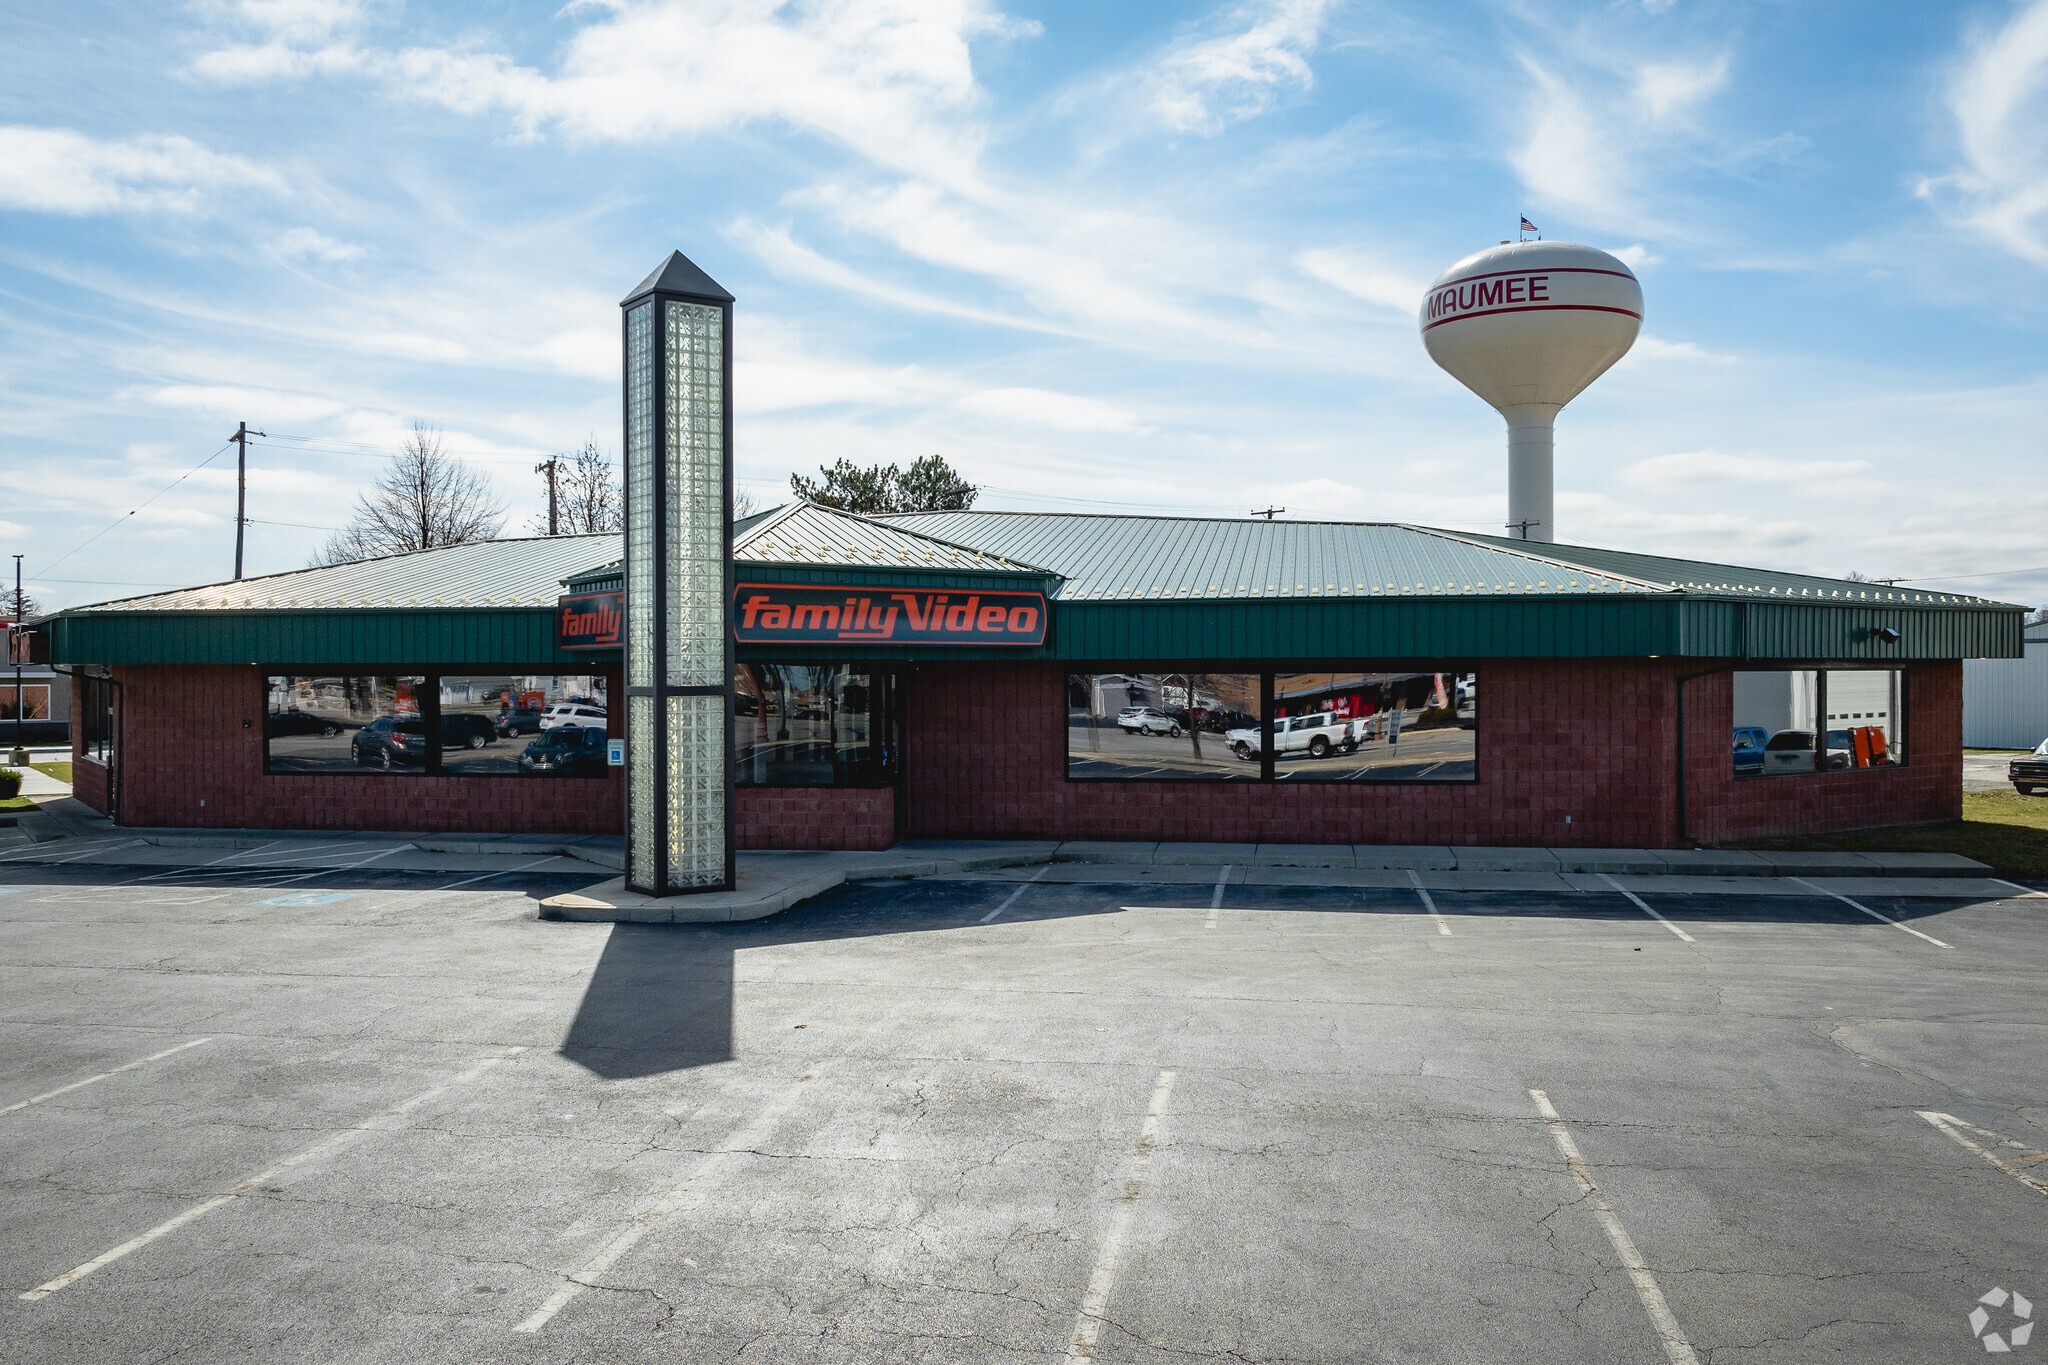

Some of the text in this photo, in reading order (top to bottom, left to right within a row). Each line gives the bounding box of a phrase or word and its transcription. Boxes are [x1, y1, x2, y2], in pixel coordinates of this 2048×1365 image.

[1427, 276, 1549, 320] MAUMEE
[562, 603, 622, 642] family
[742, 594, 1039, 639] family Video
